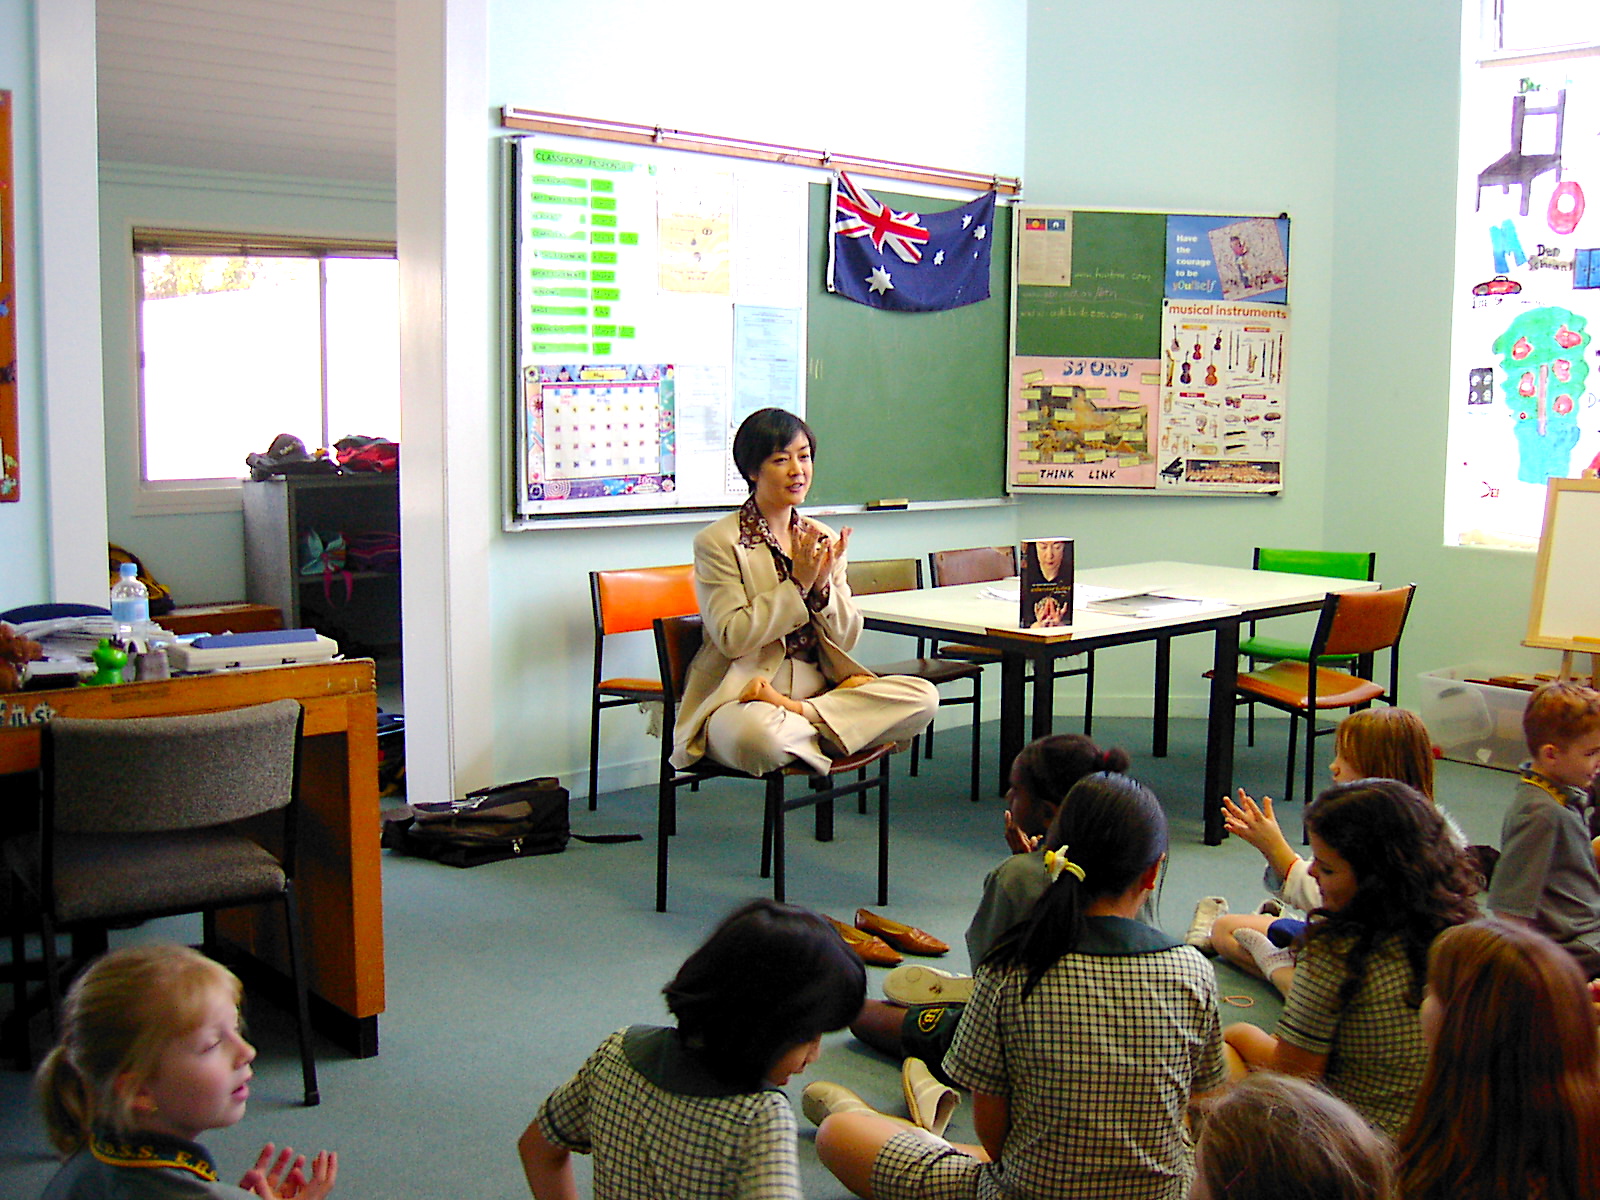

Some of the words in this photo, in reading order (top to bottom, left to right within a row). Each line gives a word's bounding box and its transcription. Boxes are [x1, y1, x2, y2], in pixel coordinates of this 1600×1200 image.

[535, 152, 584, 165] CLASSROOM
[1176, 234, 1198, 243] Have
[1176, 246, 1191, 254] the
[1176, 259, 1212, 268] courage
[1168, 304, 1213, 316] musical
[1215, 305, 1288, 320] instruments
[1062, 360, 1134, 378] SPORT
[1040, 469, 1074, 479] THINK
[1088, 469, 1117, 480] LINK
